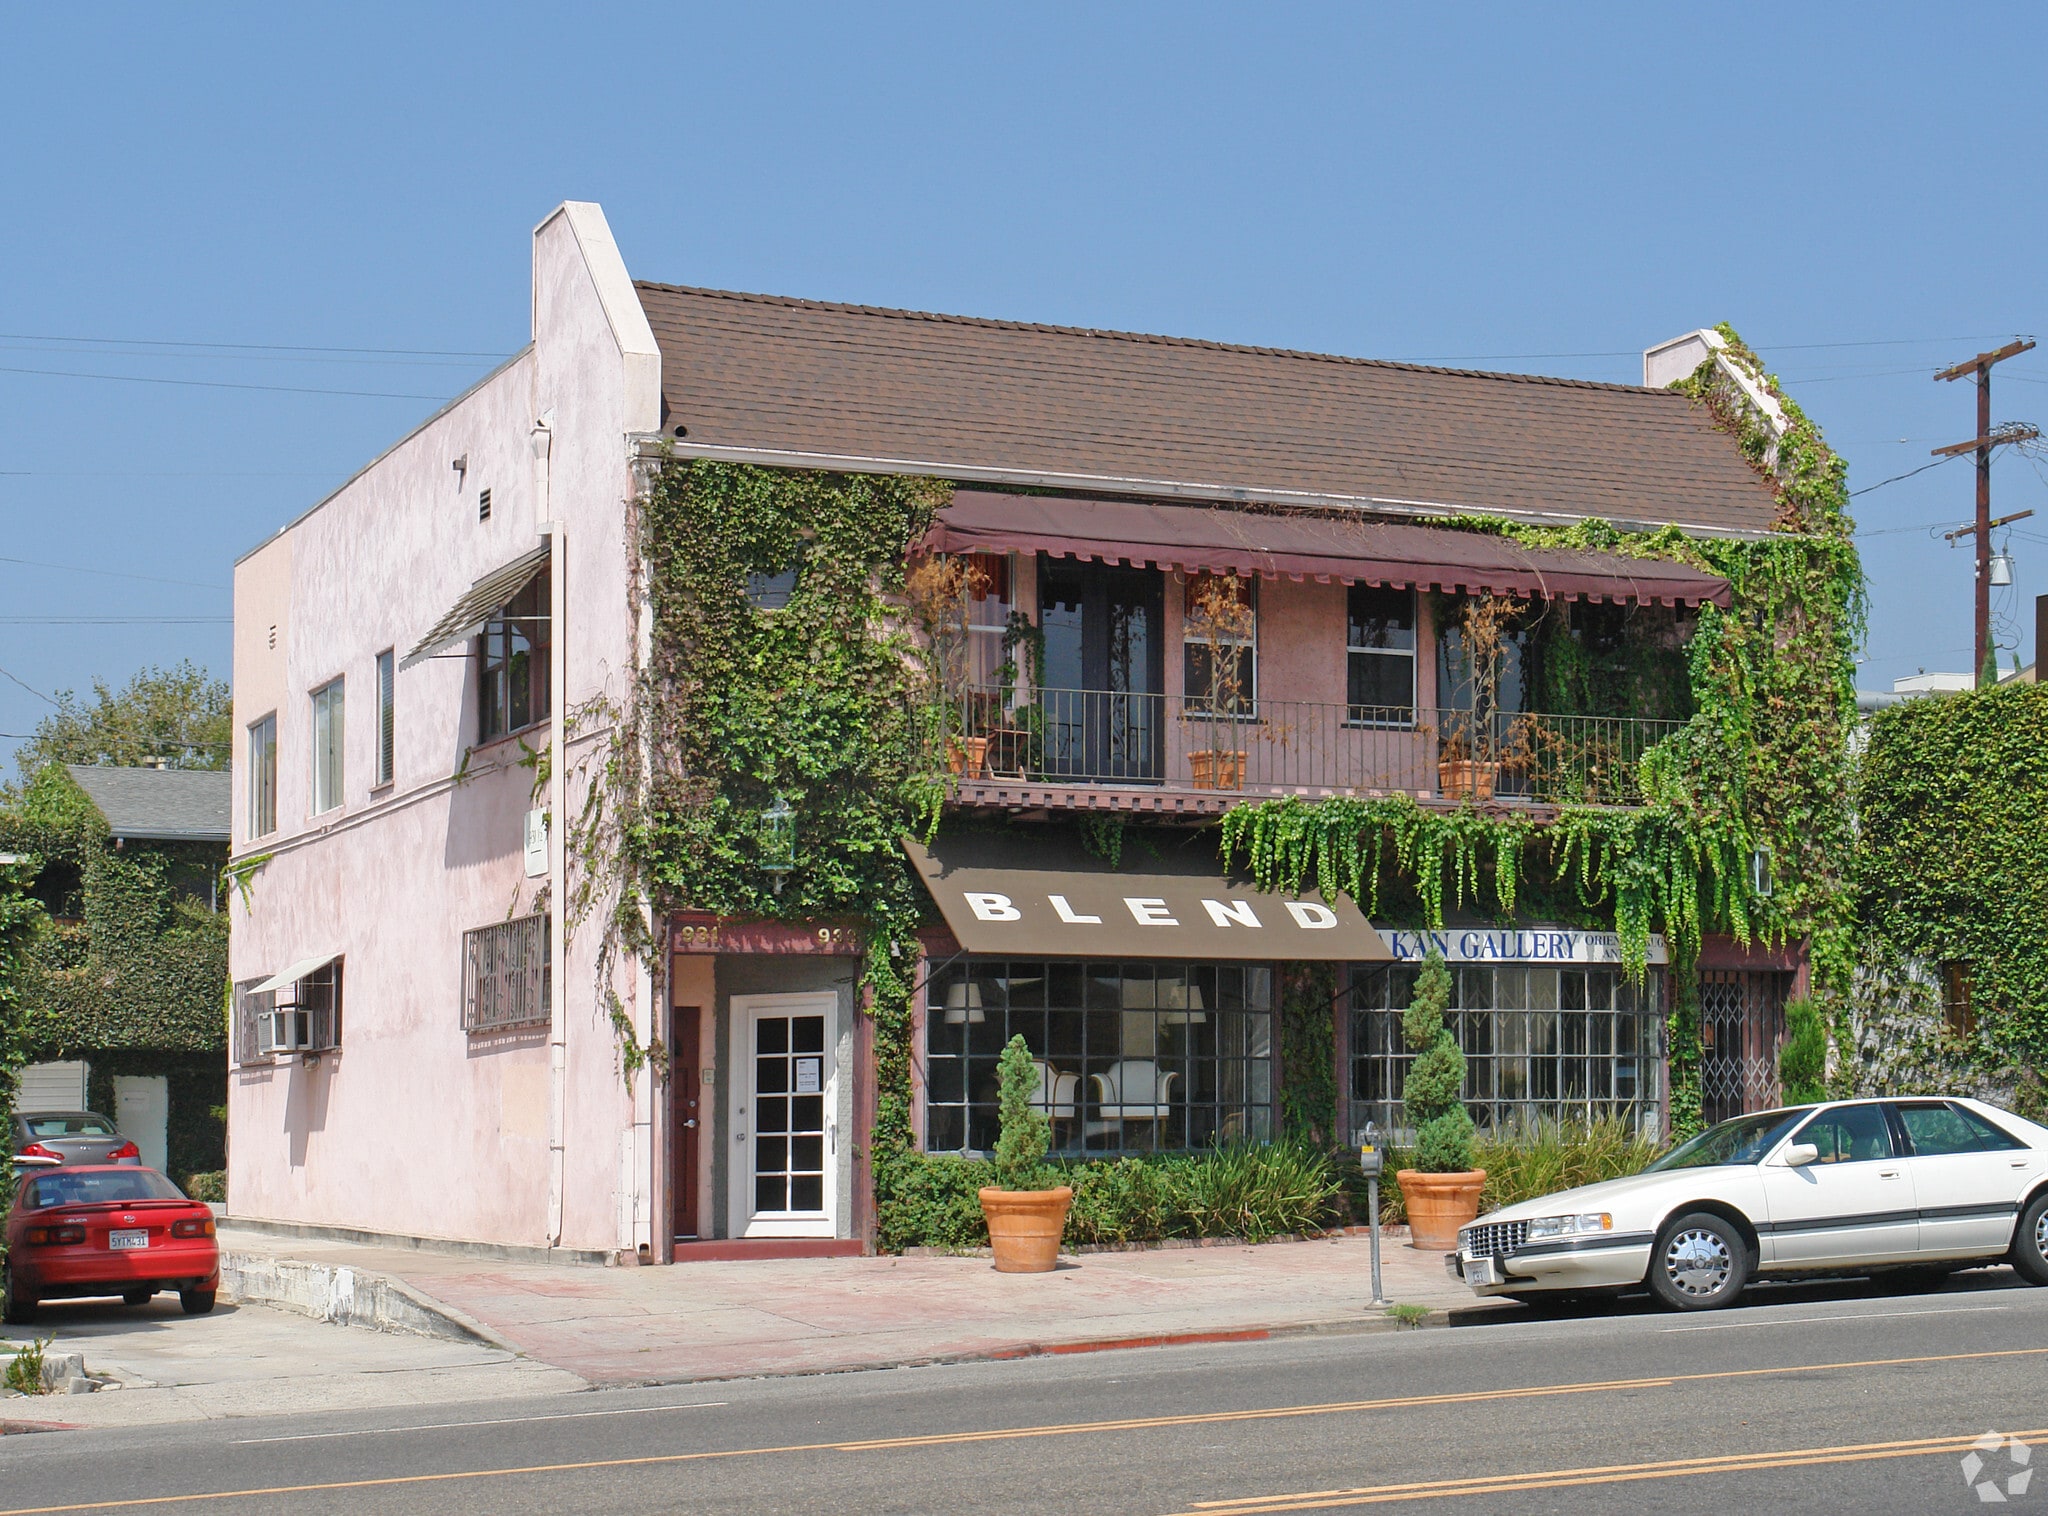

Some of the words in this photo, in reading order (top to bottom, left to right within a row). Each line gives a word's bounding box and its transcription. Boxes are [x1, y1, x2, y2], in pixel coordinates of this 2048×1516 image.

[963, 891, 1339, 930] BLEND
[682, 926, 719, 944] 931
[1379, 932, 1451, 958] KAN
[1460, 932, 1578, 959] GALLERY
